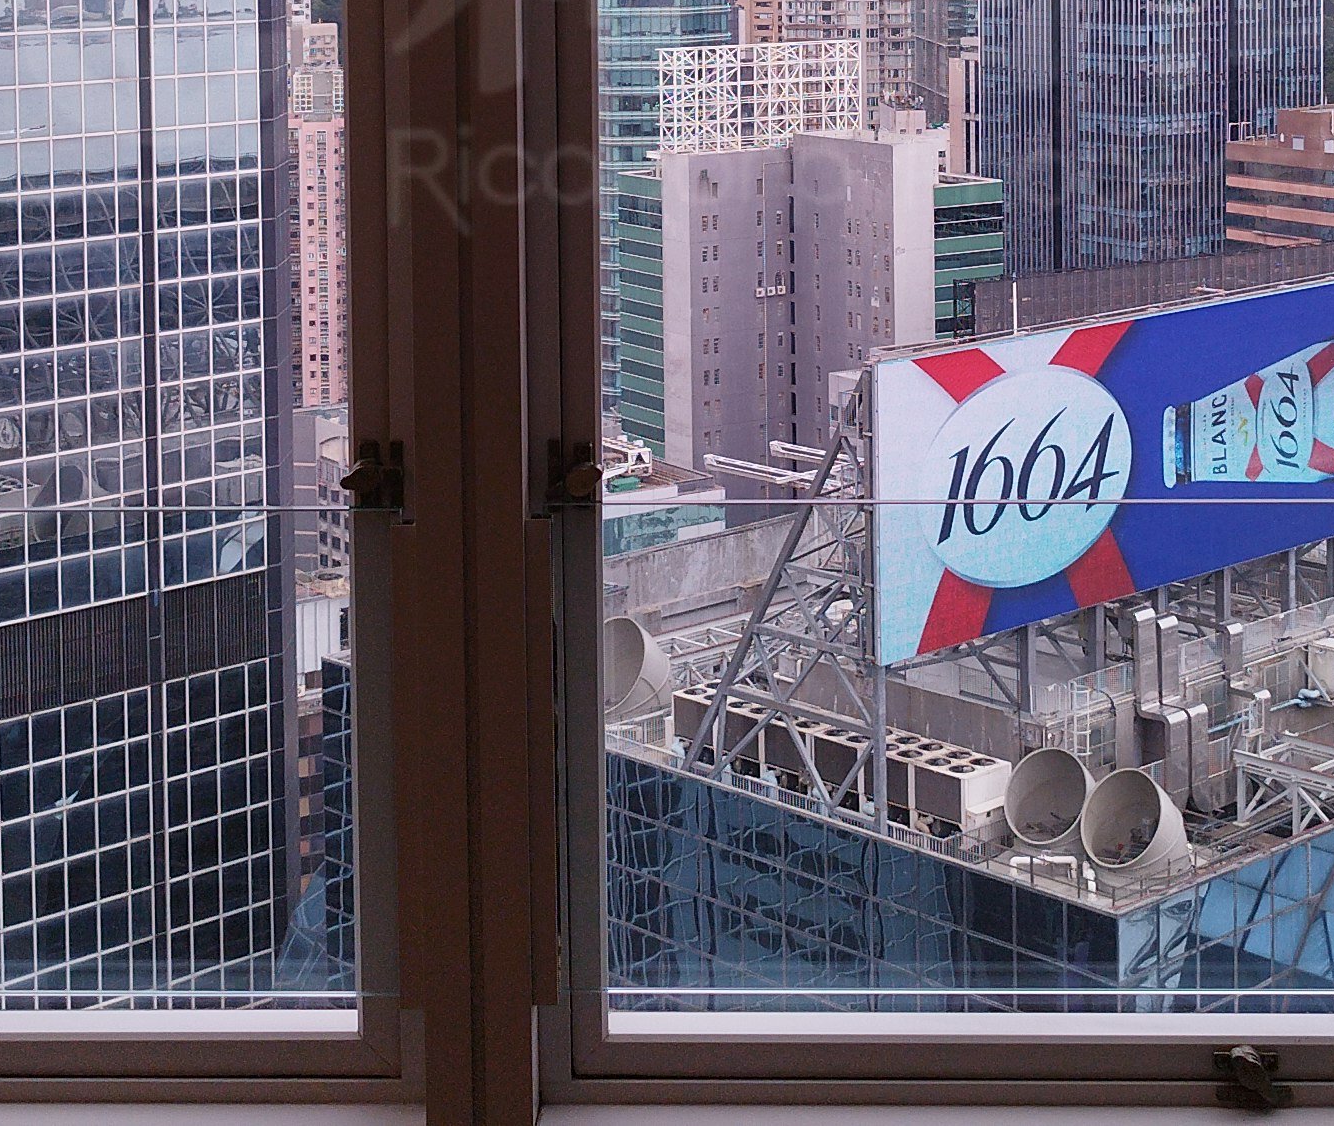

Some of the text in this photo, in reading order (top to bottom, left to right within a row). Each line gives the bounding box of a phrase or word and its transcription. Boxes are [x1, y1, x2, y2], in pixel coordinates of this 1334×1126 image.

[1211, 394, 1227, 475] BLANC
[1269, 362, 1300, 469] 1664
[937, 406, 1120, 546] 1664
